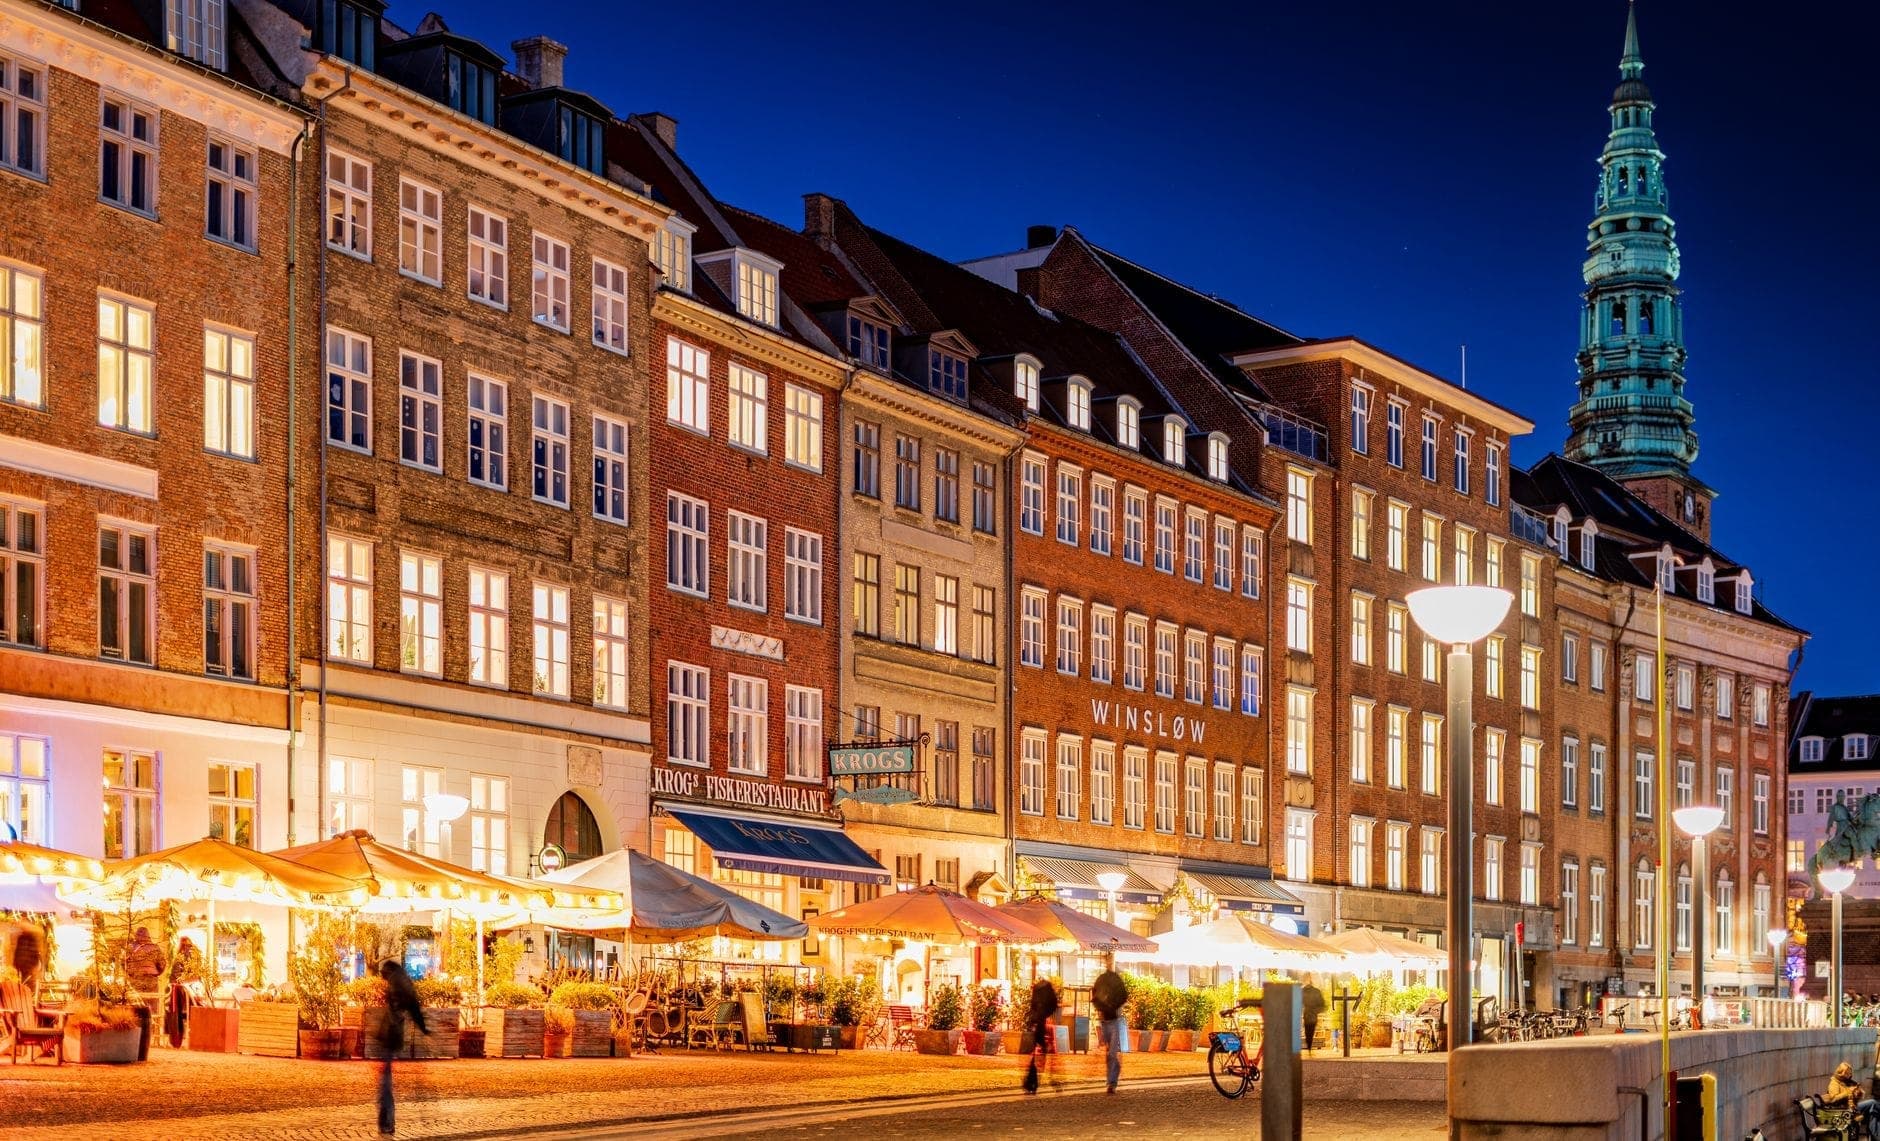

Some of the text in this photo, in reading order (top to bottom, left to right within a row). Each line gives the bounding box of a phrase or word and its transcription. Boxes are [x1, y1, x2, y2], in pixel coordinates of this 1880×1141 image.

[1091, 698, 1206, 744] WINSLØW
[833, 751, 906, 771] KROGS
[706, 775, 826, 814] FISKERESTAURANT
[730, 820, 810, 845] KROGS
